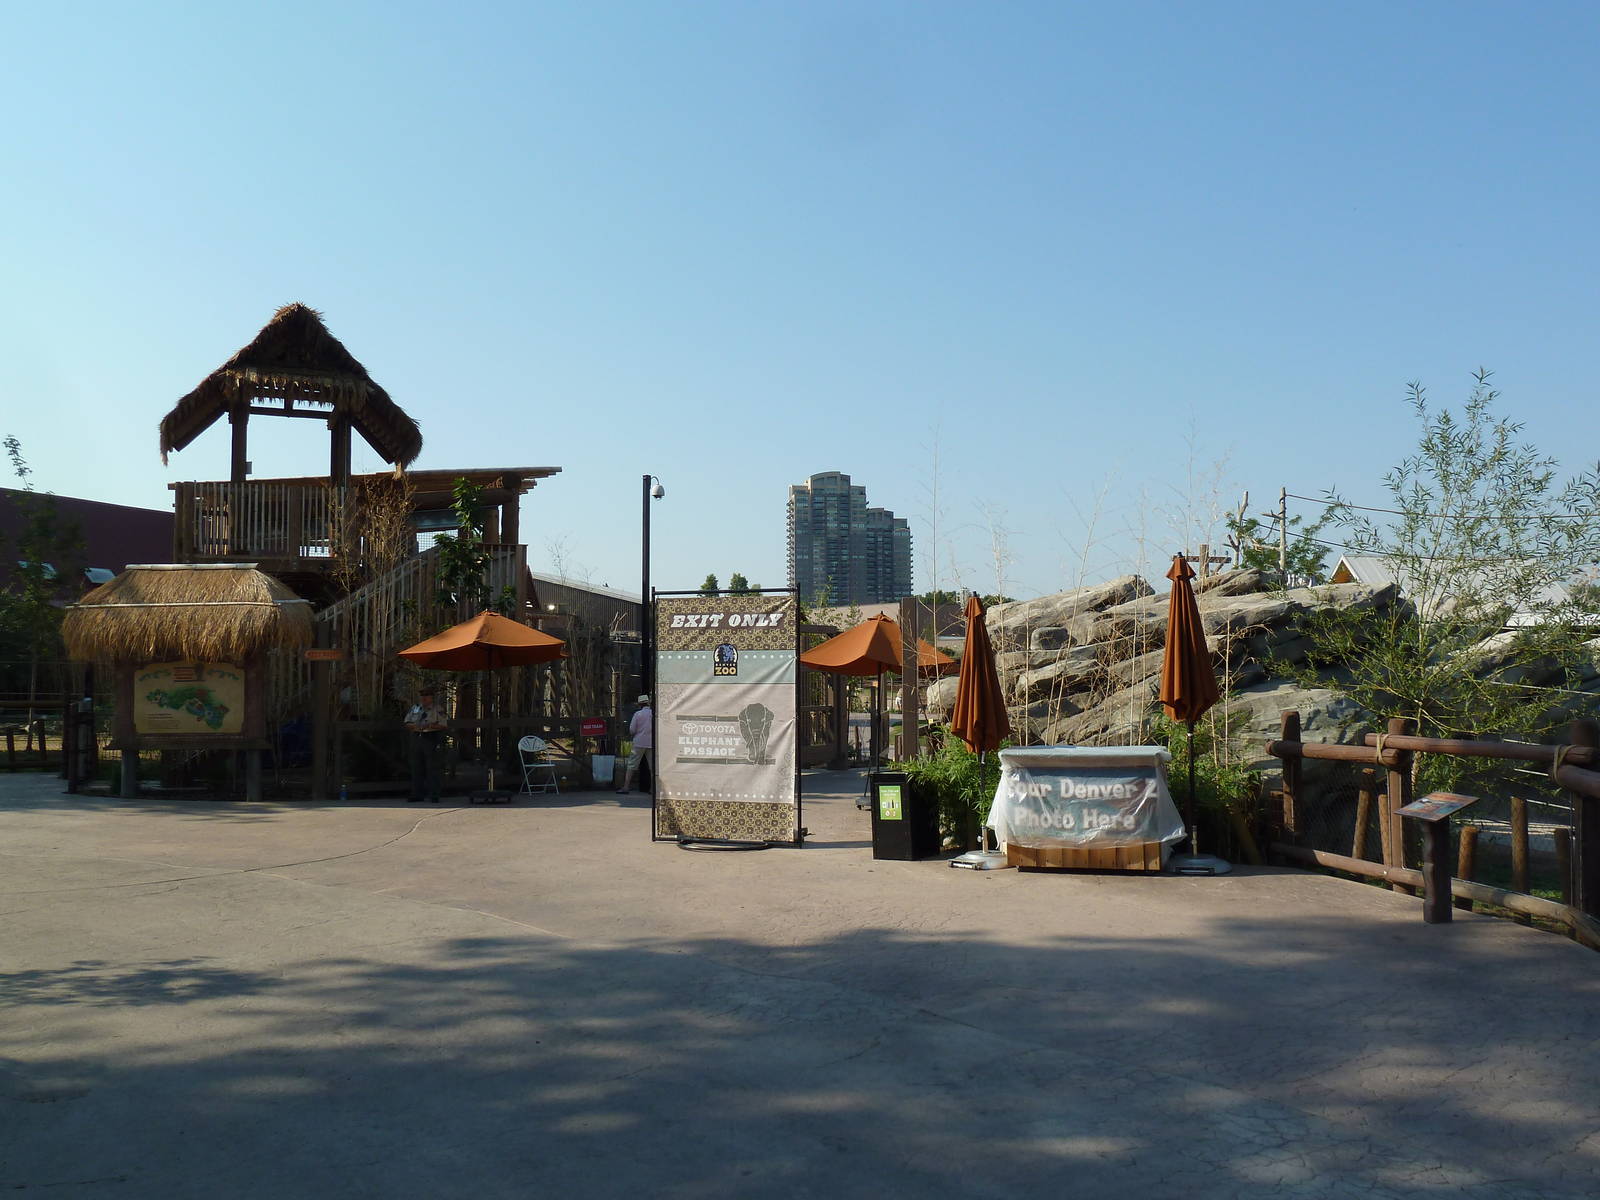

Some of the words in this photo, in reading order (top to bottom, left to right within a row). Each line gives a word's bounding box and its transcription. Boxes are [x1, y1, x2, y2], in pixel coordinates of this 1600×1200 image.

[671, 613, 724, 628] EXIT
[728, 613, 783, 627] ONLY
[715, 667, 736, 675] ZOO
[699, 725, 736, 734] TOYOTA
[679, 736, 742, 746] ELEPHANT
[1007, 780, 1052, 798] our
[1060, 778, 1138, 799] Denver
[1014, 807, 1075, 829] Photo
[1082, 808, 1136, 830] Here
